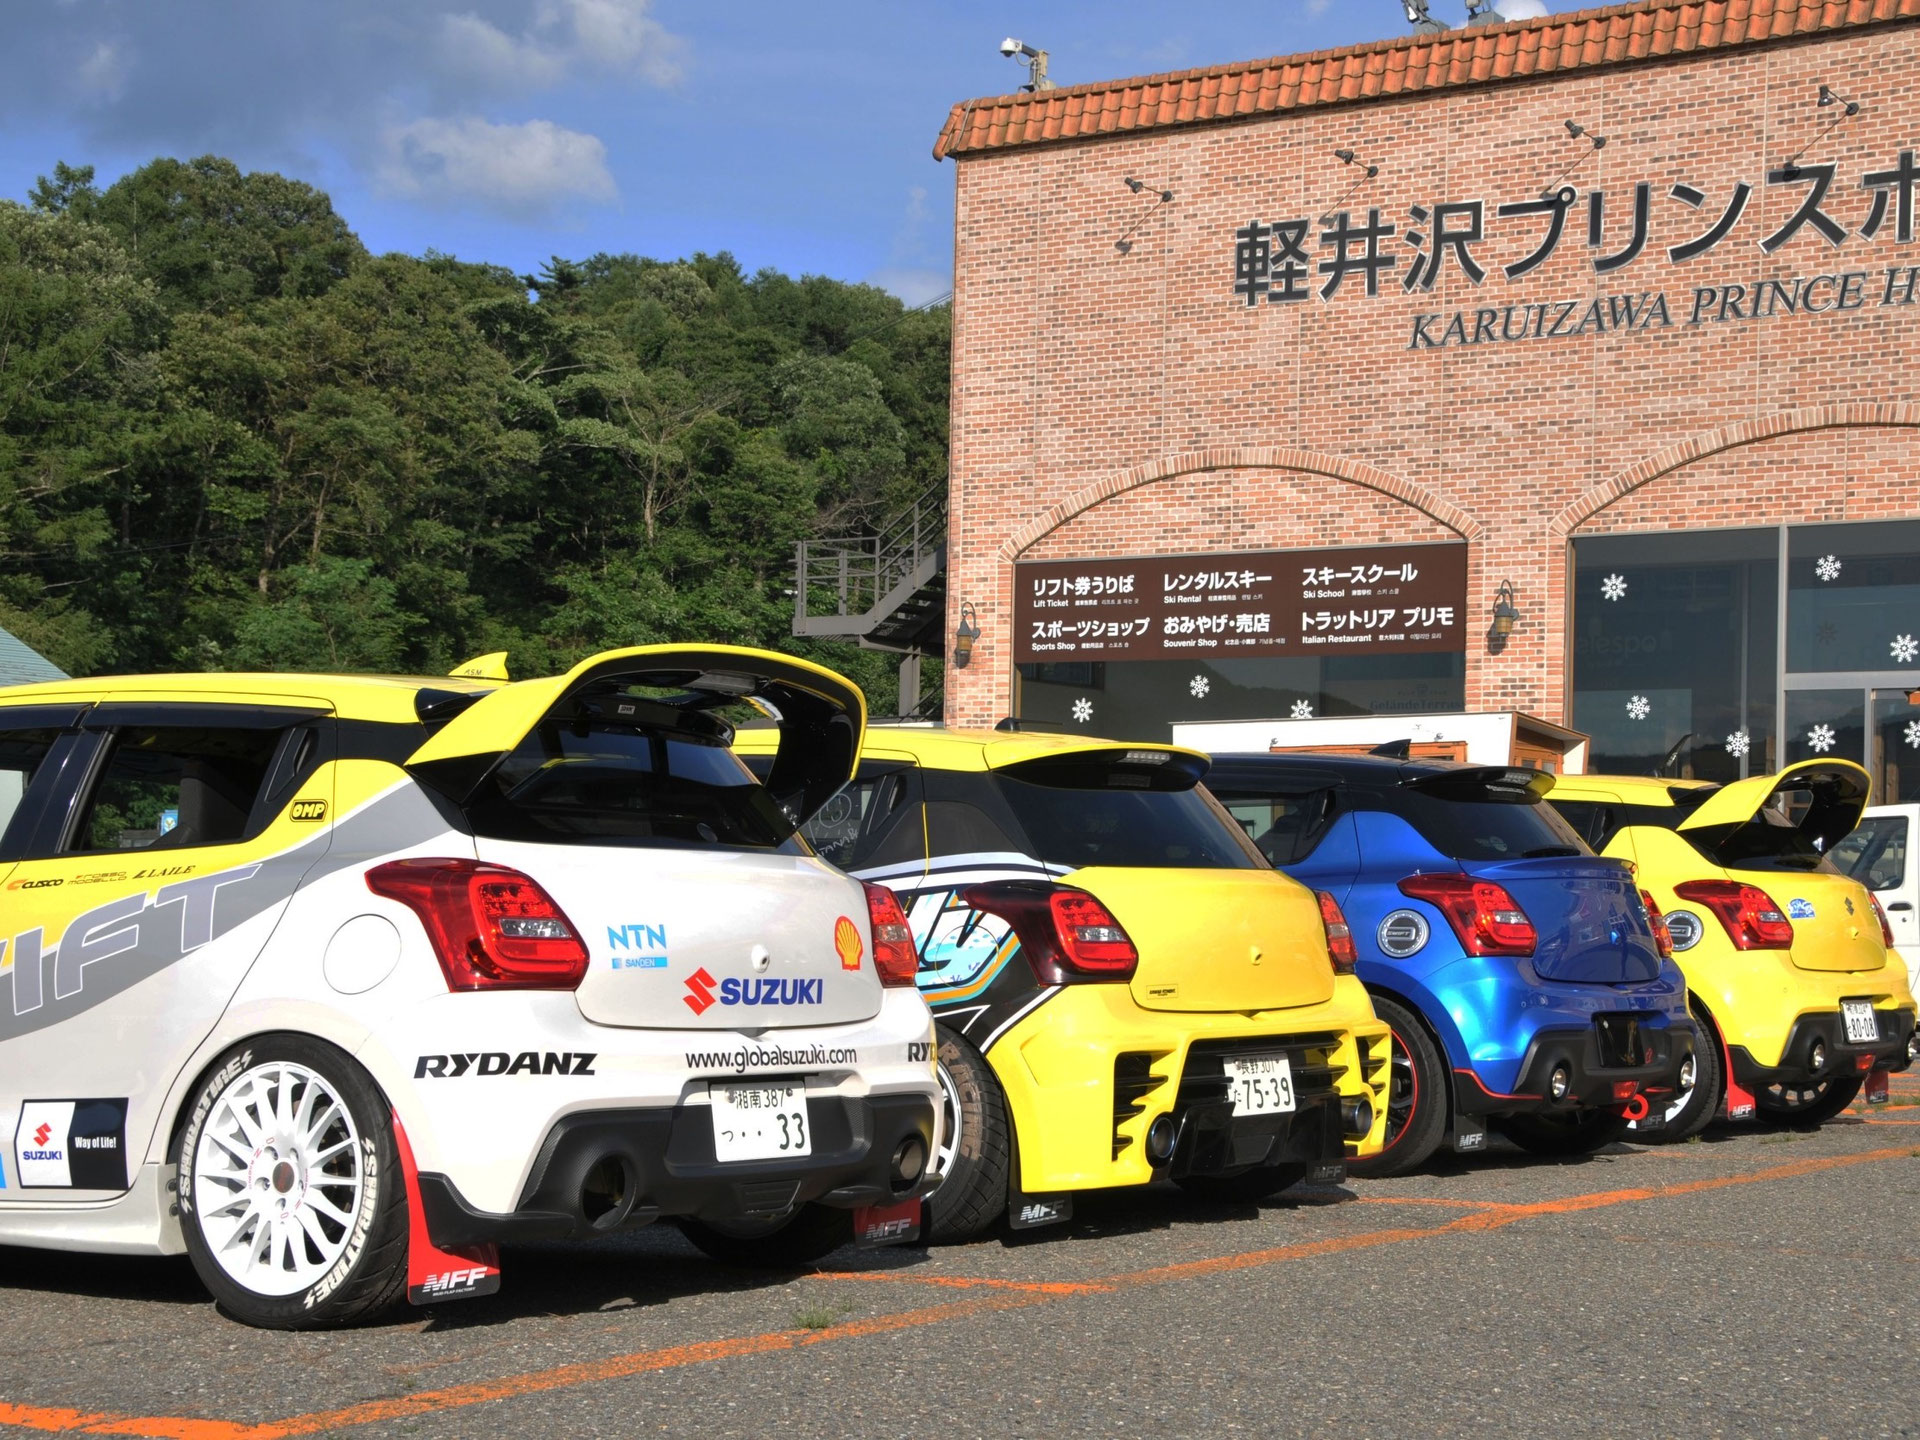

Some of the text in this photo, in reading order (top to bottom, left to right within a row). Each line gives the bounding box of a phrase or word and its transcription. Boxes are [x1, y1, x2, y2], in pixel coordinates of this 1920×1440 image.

[1405, 266, 1920, 350] KARUIZAWA PRINCE H
[1034, 574, 1135, 596] リフト券うりば
[1164, 570, 1273, 592] レンタルスキー
[1302, 563, 1418, 586] スキースクール
[1033, 600, 1046, 608] Lift
[1047, 599, 1069, 607] Ticket
[1163, 595, 1176, 604] Ski
[1177, 594, 1202, 603] Rental
[1303, 589, 1345, 599] Ski School
[1031, 616, 1151, 638] スポーツショップ
[1163, 612, 1271, 634] おみやげ・売店
[1302, 606, 1454, 632] トラットリア プリモ
[1031, 642, 1076, 652] Sports Shop
[1163, 638, 1218, 648] Souvenir Shop
[1302, 634, 1372, 644] Italian Restaurant
[292, 803, 326, 818] OMP
[0, 863, 263, 1016] IFT
[607, 924, 668, 950] NTN
[720, 977, 824, 1006] SUZUKI
[413, 1052, 599, 1079] RYDANZ
[686, 1044, 858, 1073] www.globalsuzuki.com
[1732, 1104, 1752, 1116] MFF
[75, 1136, 117, 1149] Way of Life!
[1459, 1133, 1483, 1147] MFF
[23, 1150, 62, 1160] SUZUKI
[1020, 1204, 1064, 1221] MFF
[866, 1218, 912, 1239] MFF
[422, 1267, 488, 1293] MFF
